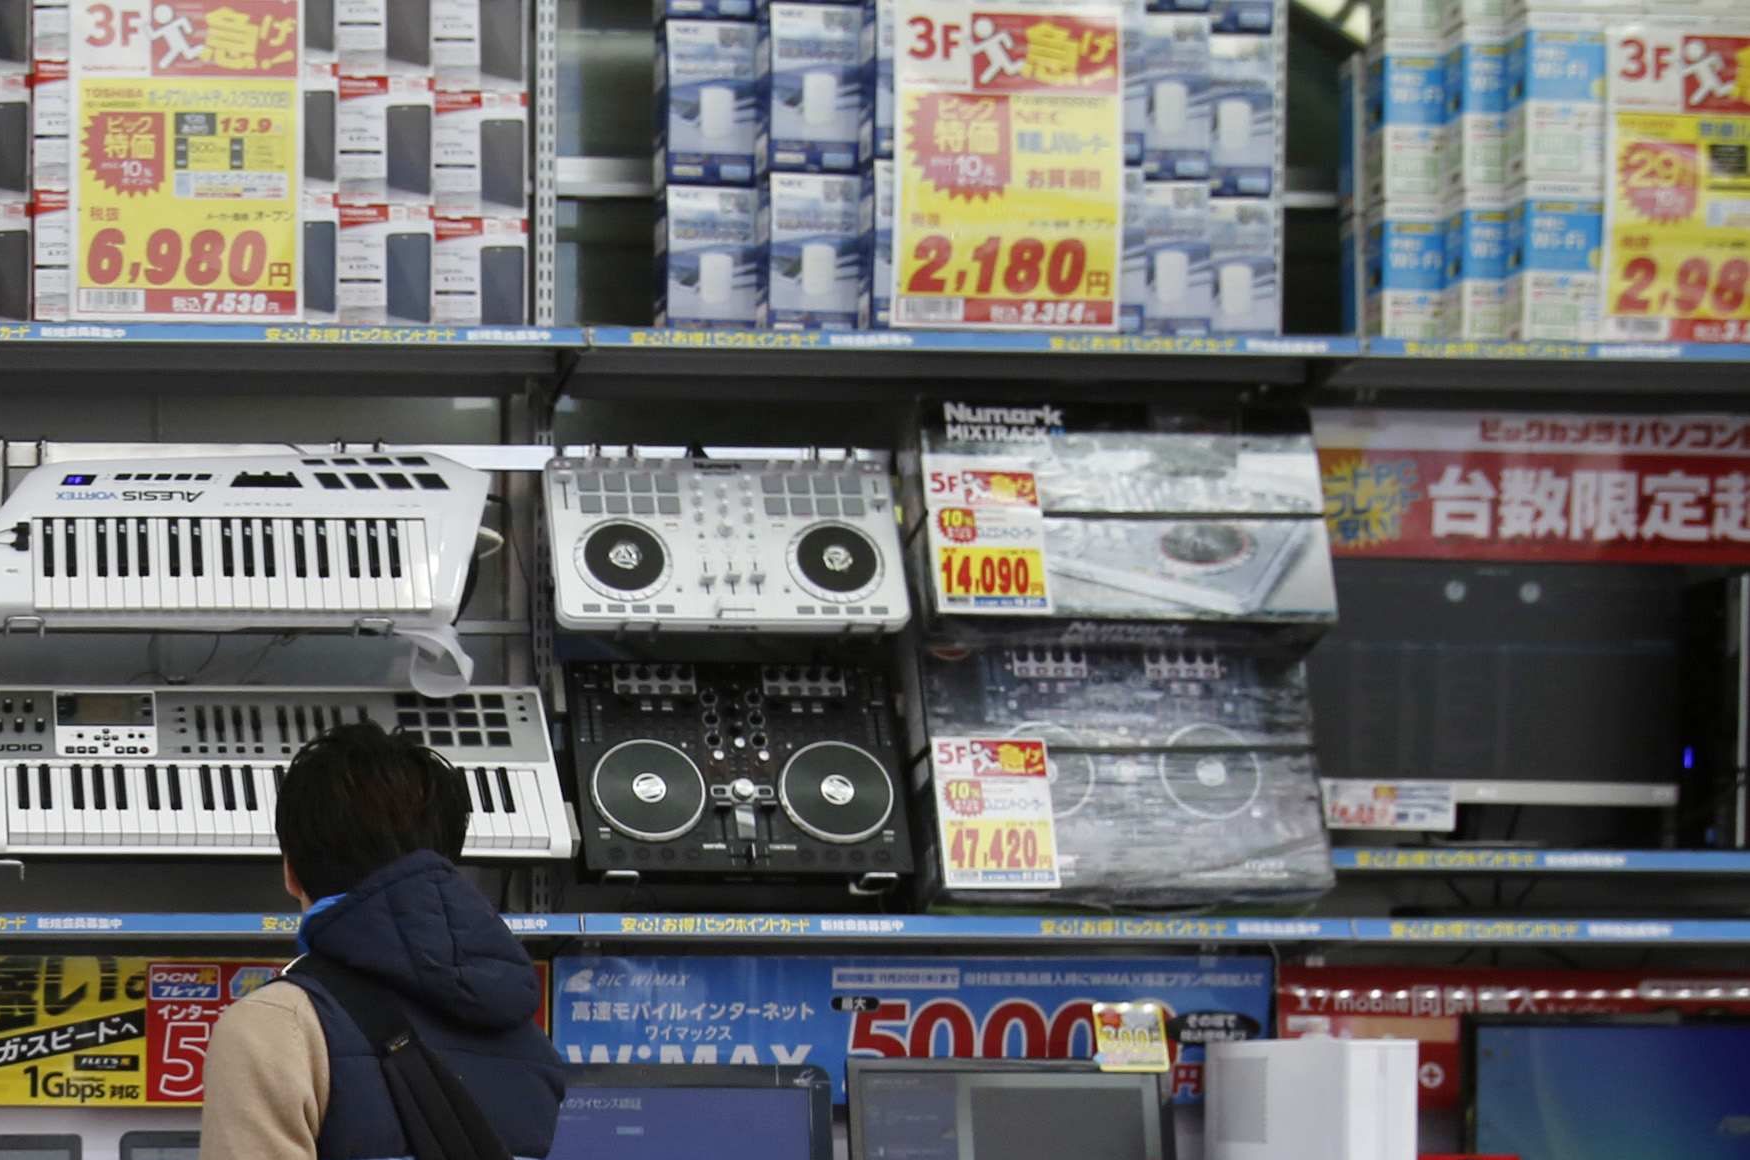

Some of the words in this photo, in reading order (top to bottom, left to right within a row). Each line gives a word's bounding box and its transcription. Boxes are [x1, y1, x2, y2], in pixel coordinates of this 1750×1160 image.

[83, 3, 142, 50] 3F
[906, 15, 962, 61] 3F
[1618, 37, 1673, 81] 3F
[85, 88, 144, 99] TOSHIBA
[86, 227, 292, 288] 6,980円
[906, 234, 1110, 296] 2,180円
[944, 402, 1064, 427] Numark
[946, 425, 1049, 443] MIXTRACK
[56, 491, 118, 501] VORTEX
[122, 490, 205, 503] ALESIS
[937, 741, 967, 765] 5F
[597, 973, 622, 987] BIC
[571, 1000, 816, 1022] 高速モバイルインターネット
[644, 1025, 733, 1042] ワイマックス
[23, 1064, 106, 1103] 1Gbps
[109, 1083, 140, 1101] 対応
